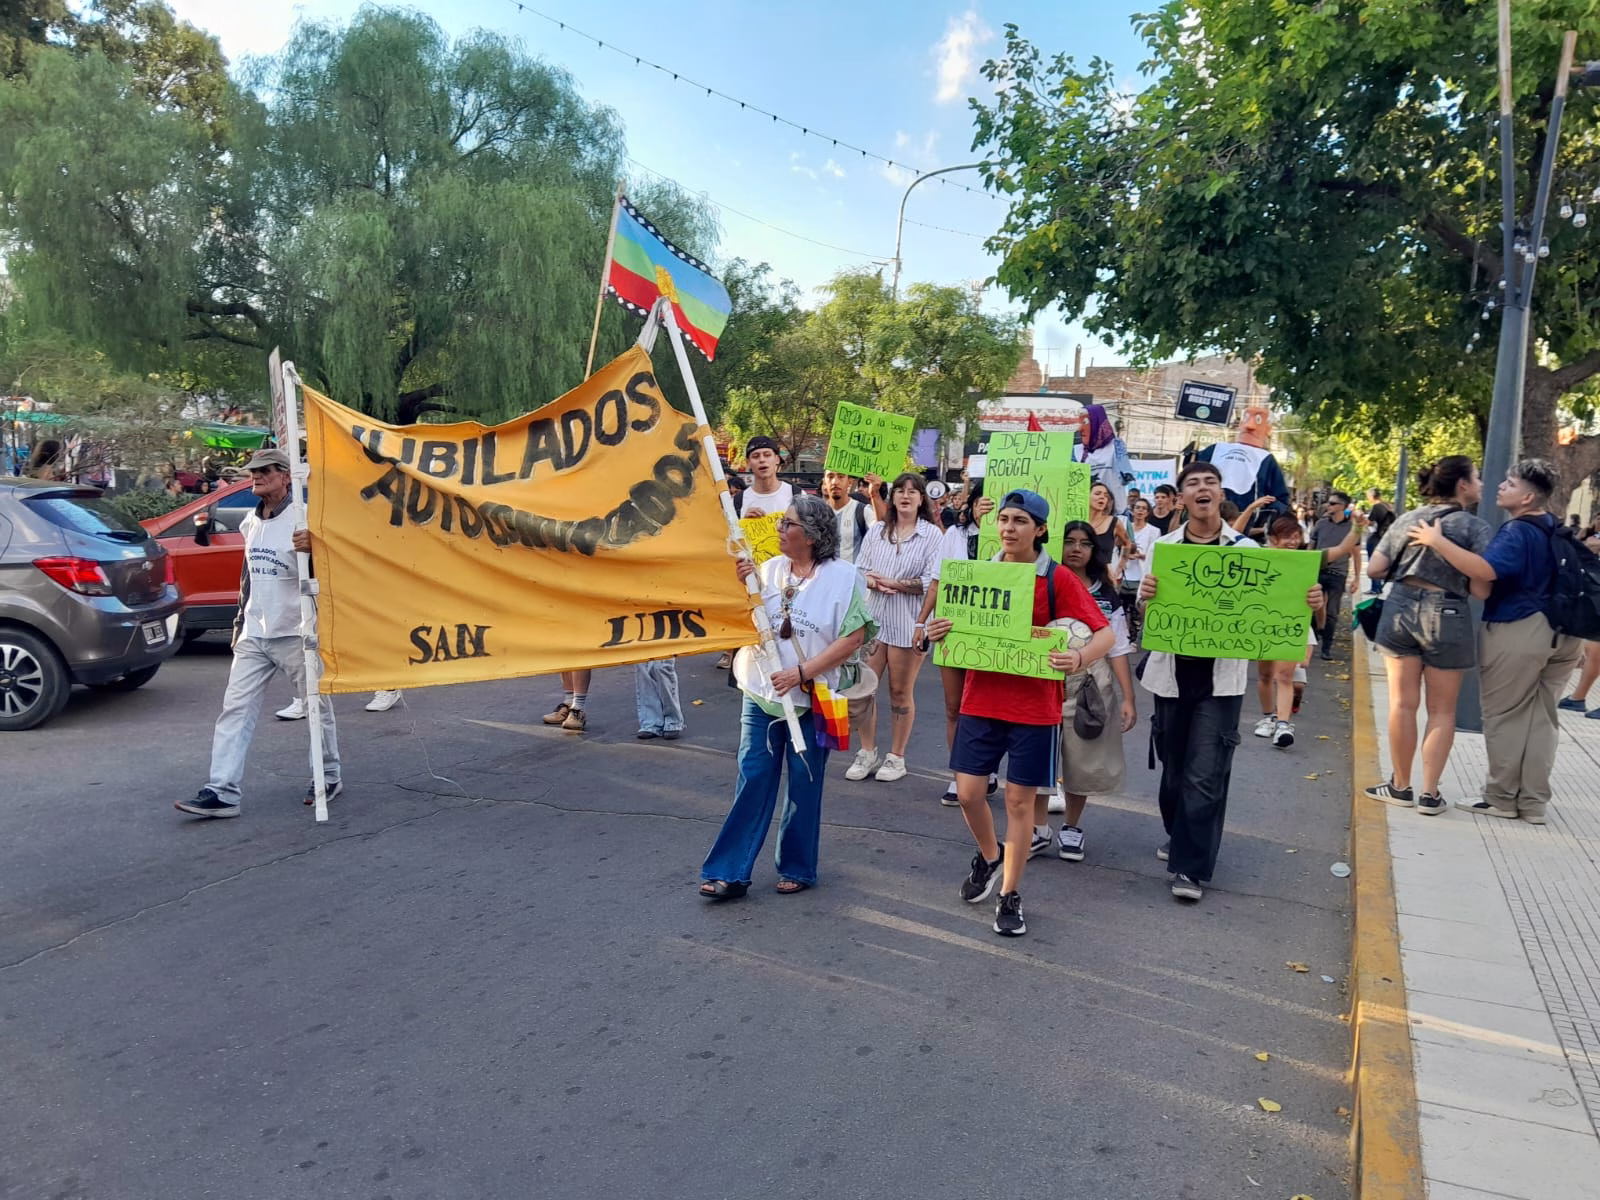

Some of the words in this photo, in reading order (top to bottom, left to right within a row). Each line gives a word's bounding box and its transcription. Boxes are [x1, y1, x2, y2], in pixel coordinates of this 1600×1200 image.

[839, 406, 862, 425] NO
[878, 418, 885, 427] la
[834, 428, 846, 440] de
[887, 441, 899, 452] de
[997, 432, 1047, 454] DEJEN
[1035, 447, 1050, 461] LA
[988, 457, 1030, 477] ROSCA
[1034, 474, 1044, 494] Y
[947, 561, 974, 581] SER
[1193, 551, 1270, 588] CGT
[409, 623, 492, 665] SAN
[600, 609, 707, 647] LUIS
[1228, 618, 1247, 636] de
[1251, 620, 1304, 638] Gordos
[953, 641, 1048, 675] COSTUMBRE
